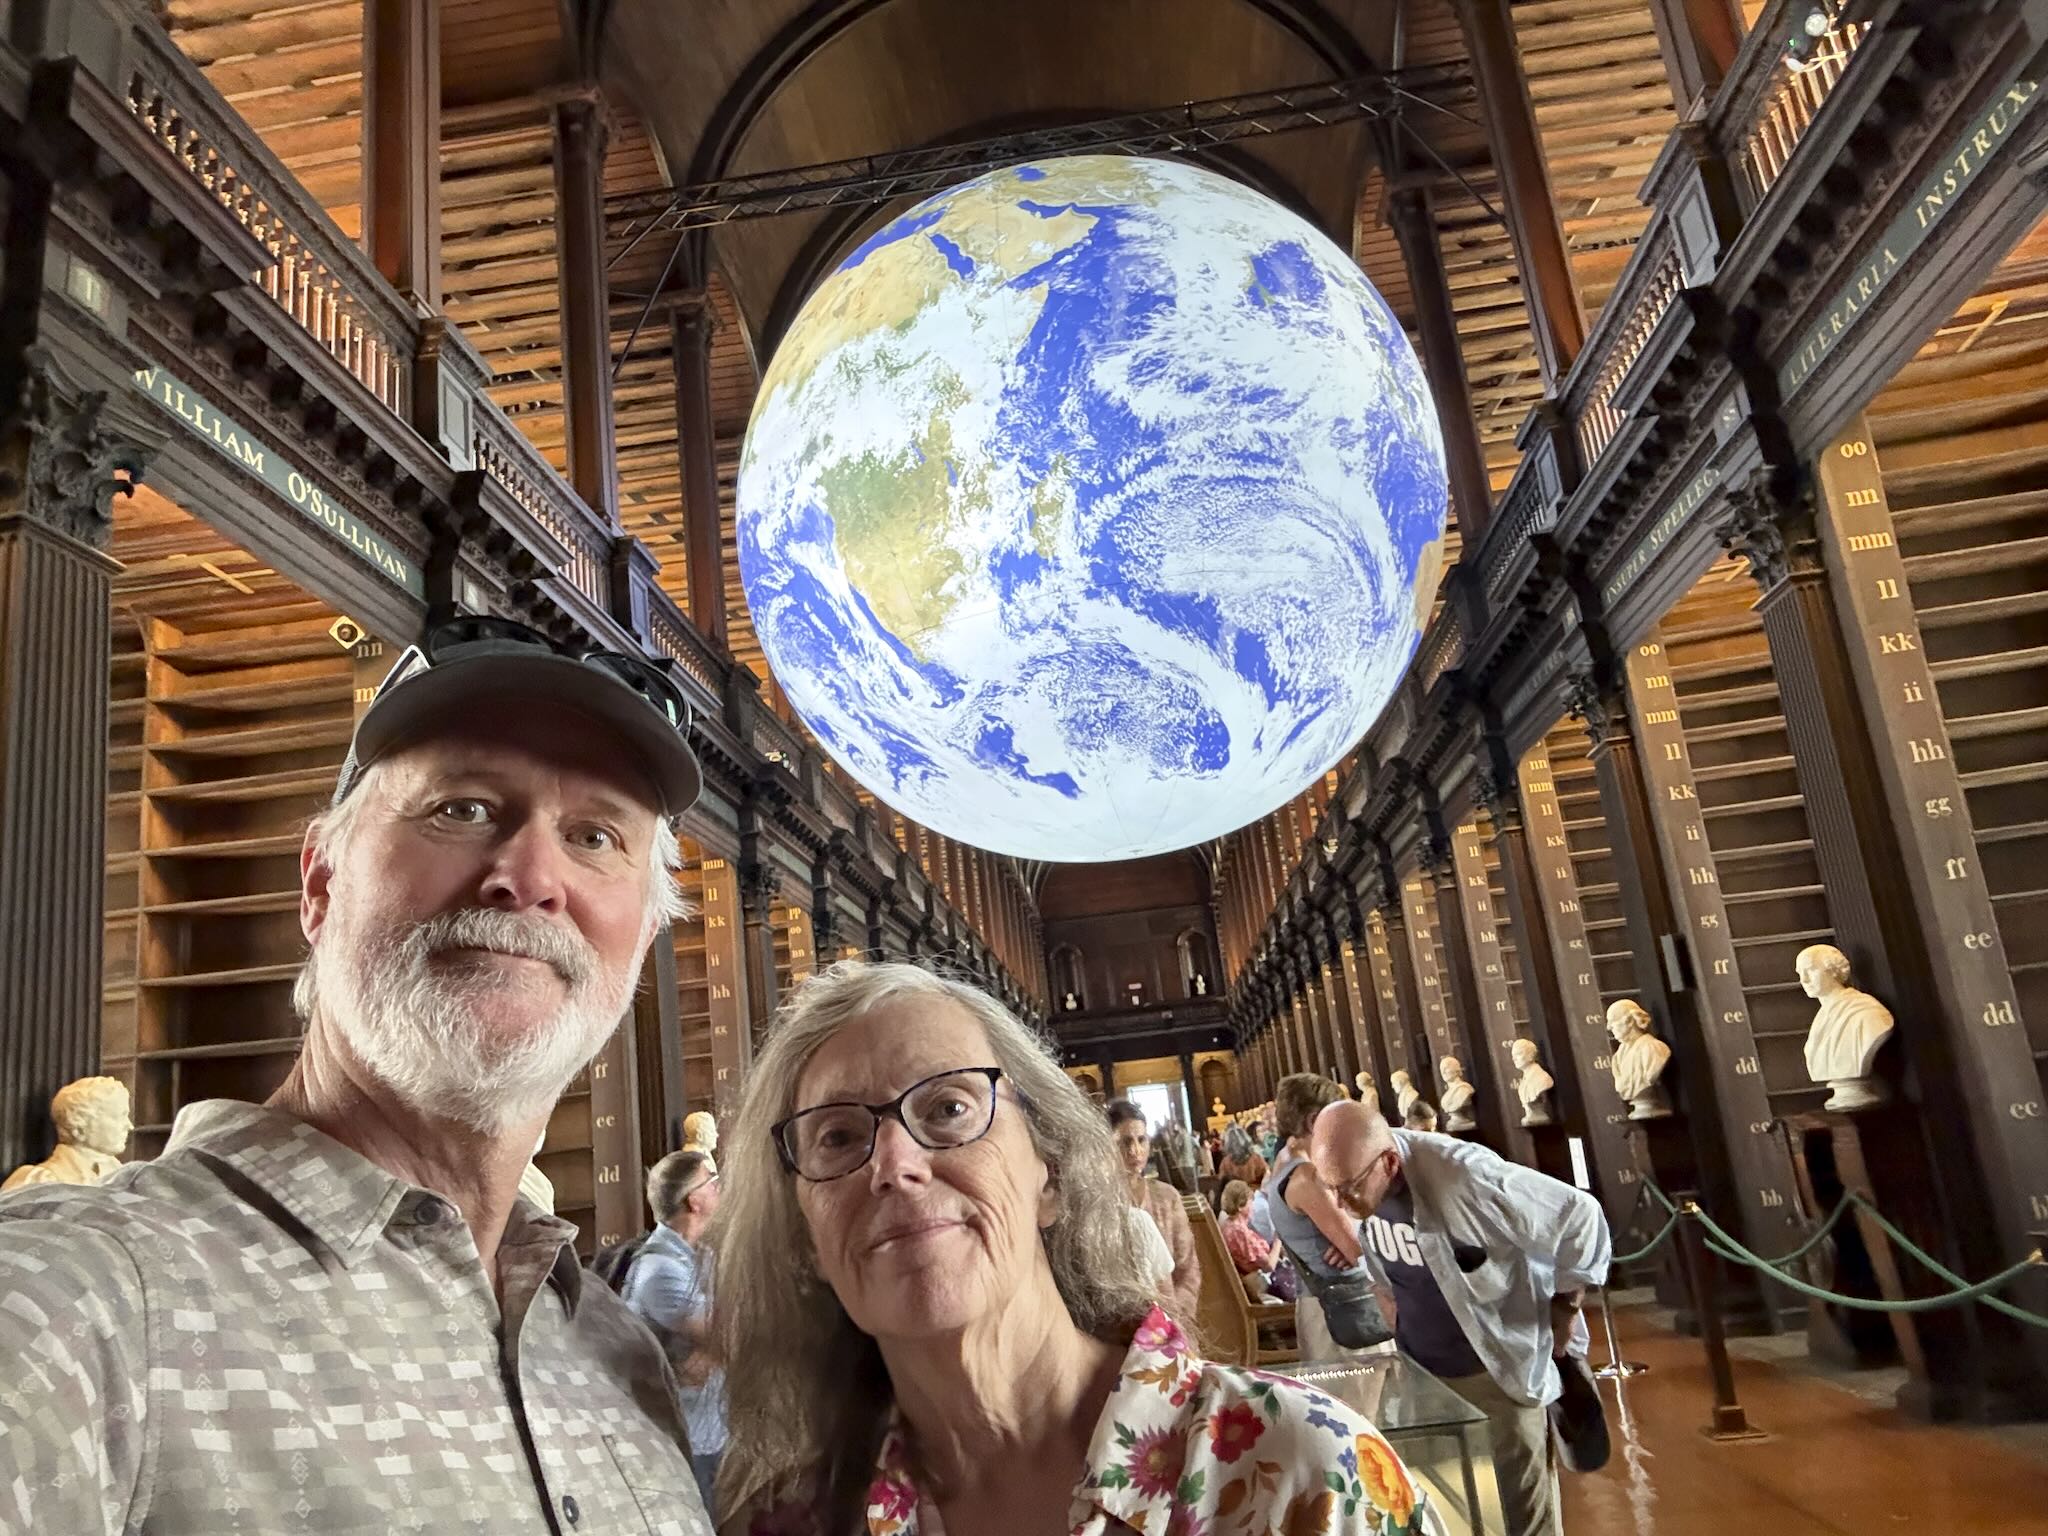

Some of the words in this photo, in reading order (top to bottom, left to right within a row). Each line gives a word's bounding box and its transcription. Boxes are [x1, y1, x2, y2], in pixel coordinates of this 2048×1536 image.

[1789, 248, 1899, 385] LITERARIA
[1840, 441, 1867, 458] oo
[1845, 487, 1880, 507] nn
[288, 471, 407, 583] O'SULLIVAN
[1848, 531, 1893, 552] mm
[1877, 578, 1899, 600] ll
[356, 642, 383, 659] nn
[1640, 643, 1660, 656] oo
[1880, 632, 1917, 654] kk
[1645, 675, 1670, 689] nn
[354, 685, 381, 703] m
[1904, 681, 1925, 703] ii
[1645, 709, 1678, 725] mm
[1664, 743, 1682, 761] ll
[1908, 738, 1946, 763] hh
[1529, 759, 1548, 770] nn
[1528, 782, 1553, 793] mm
[1668, 784, 1696, 800] kk
[1925, 797, 1953, 818] gg
[1685, 825, 1699, 841] ii
[1545, 836, 1565, 848] kk
[703, 858, 725, 870] mm
[1945, 857, 1967, 880] ff
[1468, 875, 1487, 887] kk
[1689, 866, 1715, 885] hh
[1559, 900, 1578, 914] hh
[708, 915, 726, 928] kk
[1480, 931, 1497, 943] hh
[1963, 932, 1994, 949] ee
[1713, 959, 1729, 975] ff
[712, 984, 731, 1000] hh
[1723, 1010, 1744, 1023] ee
[1983, 1001, 2016, 1026] dd
[594, 1062, 609, 1080] ff
[1735, 1056, 1758, 1075] dd
[2009, 1101, 2041, 1119] cc
[598, 1164, 620, 1184] dd
